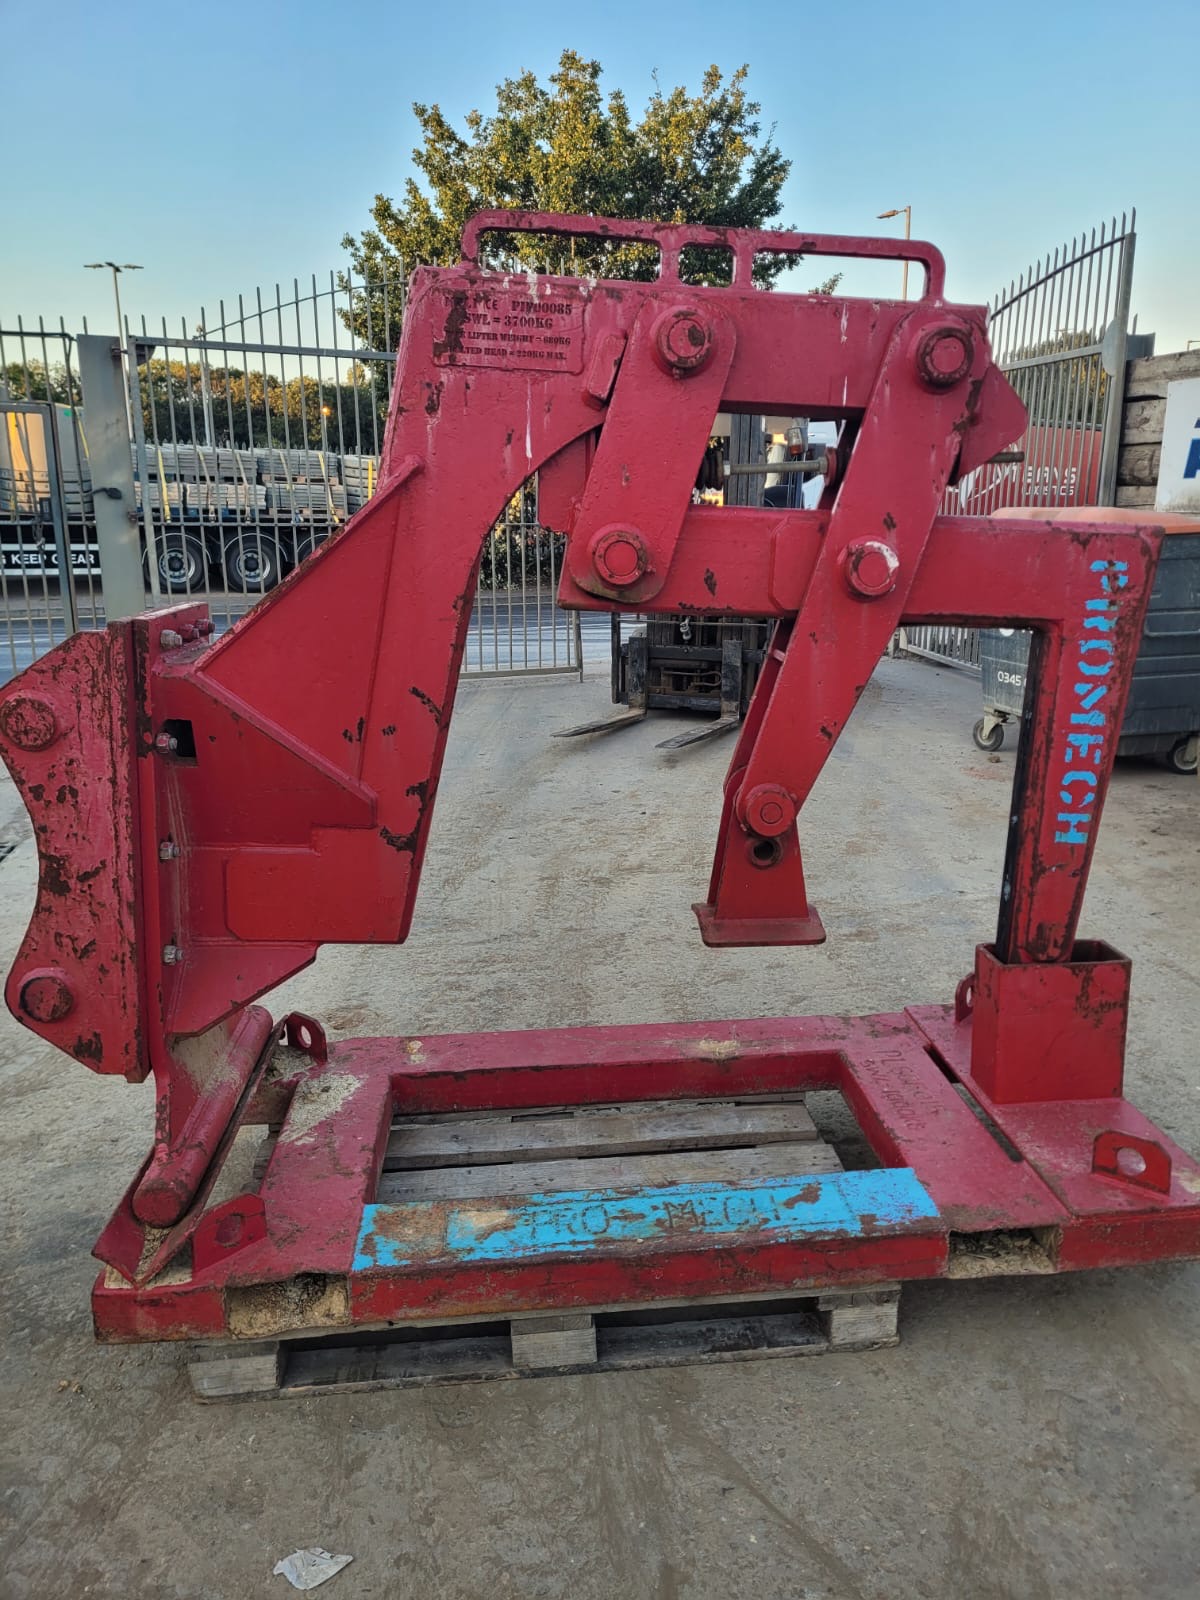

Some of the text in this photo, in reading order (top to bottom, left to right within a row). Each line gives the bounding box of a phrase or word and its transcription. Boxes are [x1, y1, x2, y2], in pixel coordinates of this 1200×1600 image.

[504, 315, 553, 329] 3700KG
[468, 331, 498, 341] LIFTER
[499, 333, 535, 344] WEIGHT
[51, 553, 95, 565] CEAR
[997, 671, 1022, 687] 0345
